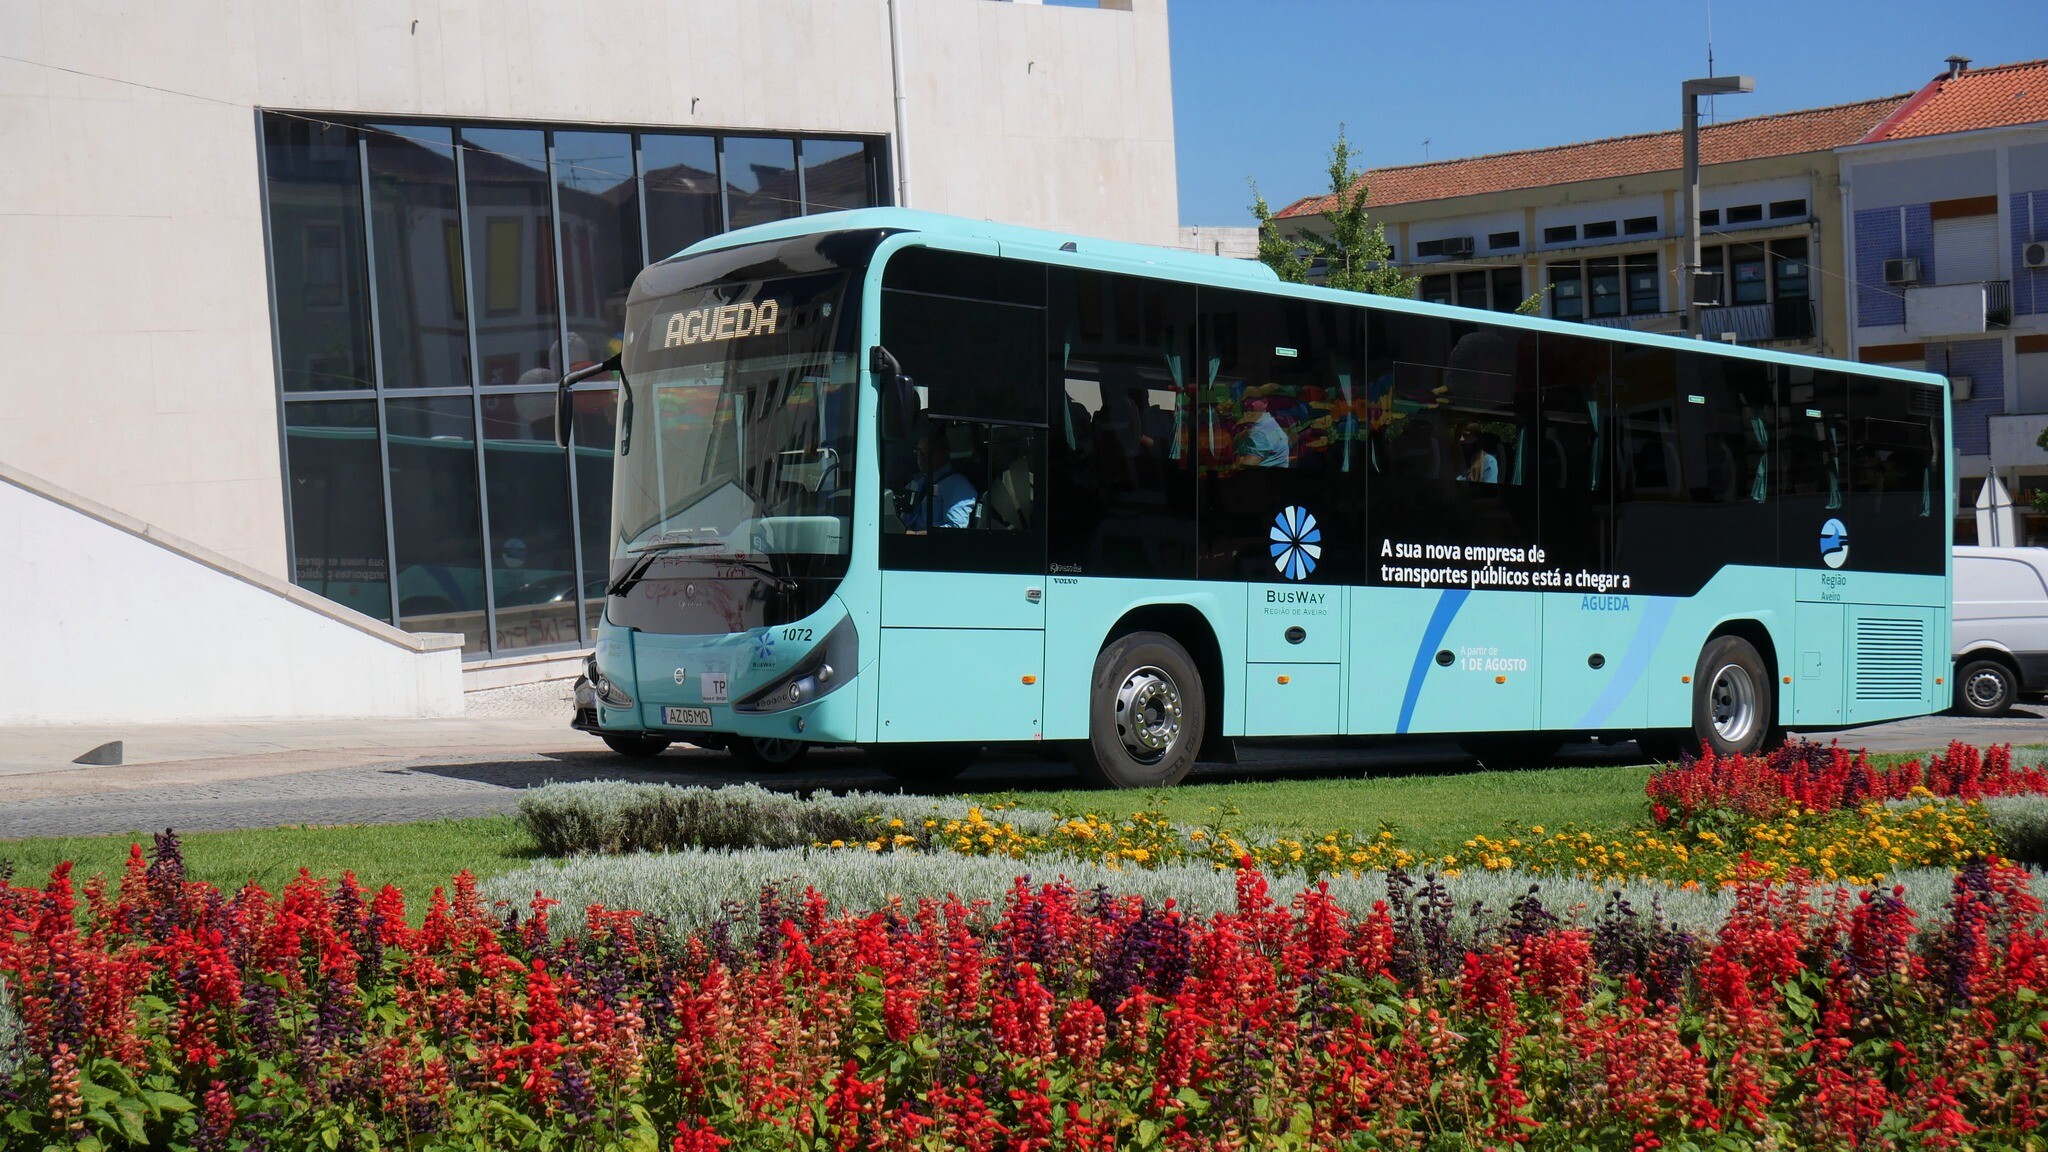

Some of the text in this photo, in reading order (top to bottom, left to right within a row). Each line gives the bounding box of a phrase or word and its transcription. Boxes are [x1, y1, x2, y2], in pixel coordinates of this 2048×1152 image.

[664, 299, 779, 348] AGUEDA
[1381, 539, 1545, 566] A sua nova empresa de
[1053, 577, 1078, 585] VOLVO
[1381, 564, 1630, 592] transportes públicos está a chegar a
[1821, 573, 1847, 589] Região
[1821, 591, 1841, 601] Aveiro
[782, 628, 813, 642] 1072
[1460, 645, 1498, 657] A partir de
[1461, 658, 1527, 671] 1 DE AGOSTO
[713, 680, 726, 694] TP
